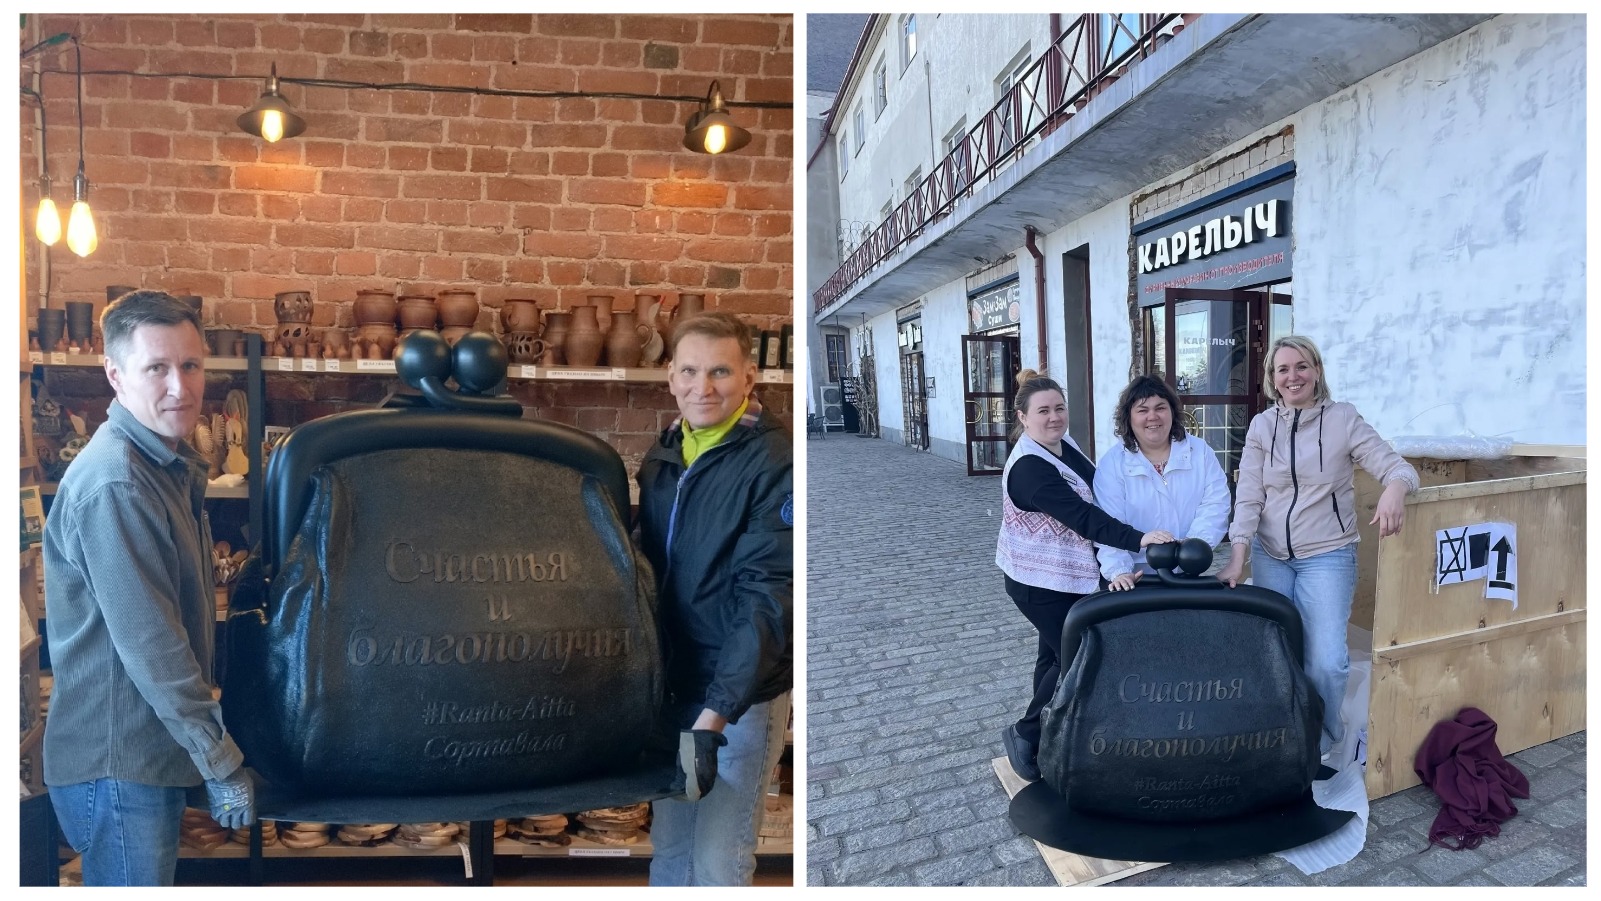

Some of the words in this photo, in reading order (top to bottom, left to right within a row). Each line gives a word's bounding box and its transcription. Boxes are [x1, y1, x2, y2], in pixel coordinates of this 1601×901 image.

[1138, 199, 1279, 274] КАРЕЛЫЧ
[1219, 251, 1284, 277] ПРОИЗВОДИТЕЛЯ
[1183, 336, 1236, 346] КАРЕЛЫЧ
[384, 541, 569, 583] Счастья
[486, 594, 513, 622] и
[347, 624, 633, 675] благополучия
[1119, 673, 1244, 704] Счастья
[1177, 709, 1196, 731] и
[422, 729, 567, 767] Сортавала
[1089, 726, 1288, 762] благополучия
